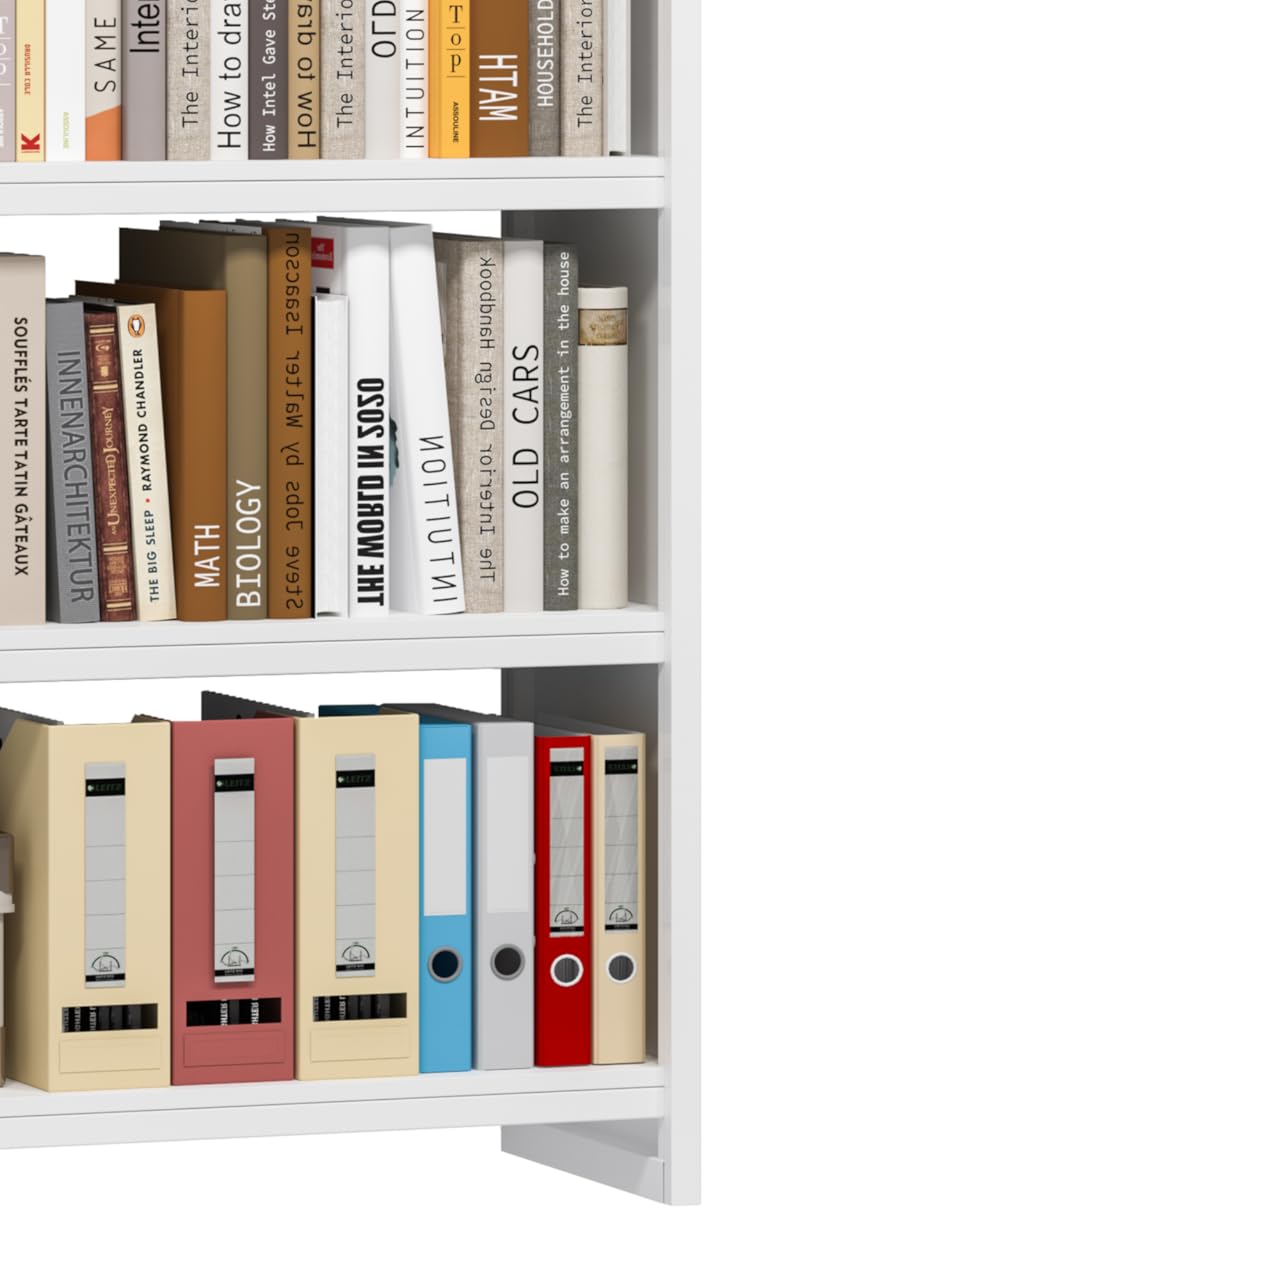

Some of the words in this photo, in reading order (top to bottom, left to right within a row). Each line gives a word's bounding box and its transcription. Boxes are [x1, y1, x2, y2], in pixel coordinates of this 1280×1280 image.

[14, 318, 31, 392] SOUFFLÉS
[133, 349, 146, 418] CHANDLER
[15, 398, 28, 446] TARTE
[102, 407, 119, 454] JOURNEY
[15, 451, 28, 496] TATIN
[58, 351, 93, 602] INNENARCHITEKTUR
[138, 423, 152, 491] RAYMOND
[106, 454, 120, 527] UNEXPECTED
[15, 504, 32, 575] GÂTEAUX
[144, 510, 155, 545] SLEEP
[194, 525, 220, 586] MATH
[236, 480, 261, 606] BIOLOGY
[147, 551, 157, 573] BIG
[149, 579, 159, 602] THE
